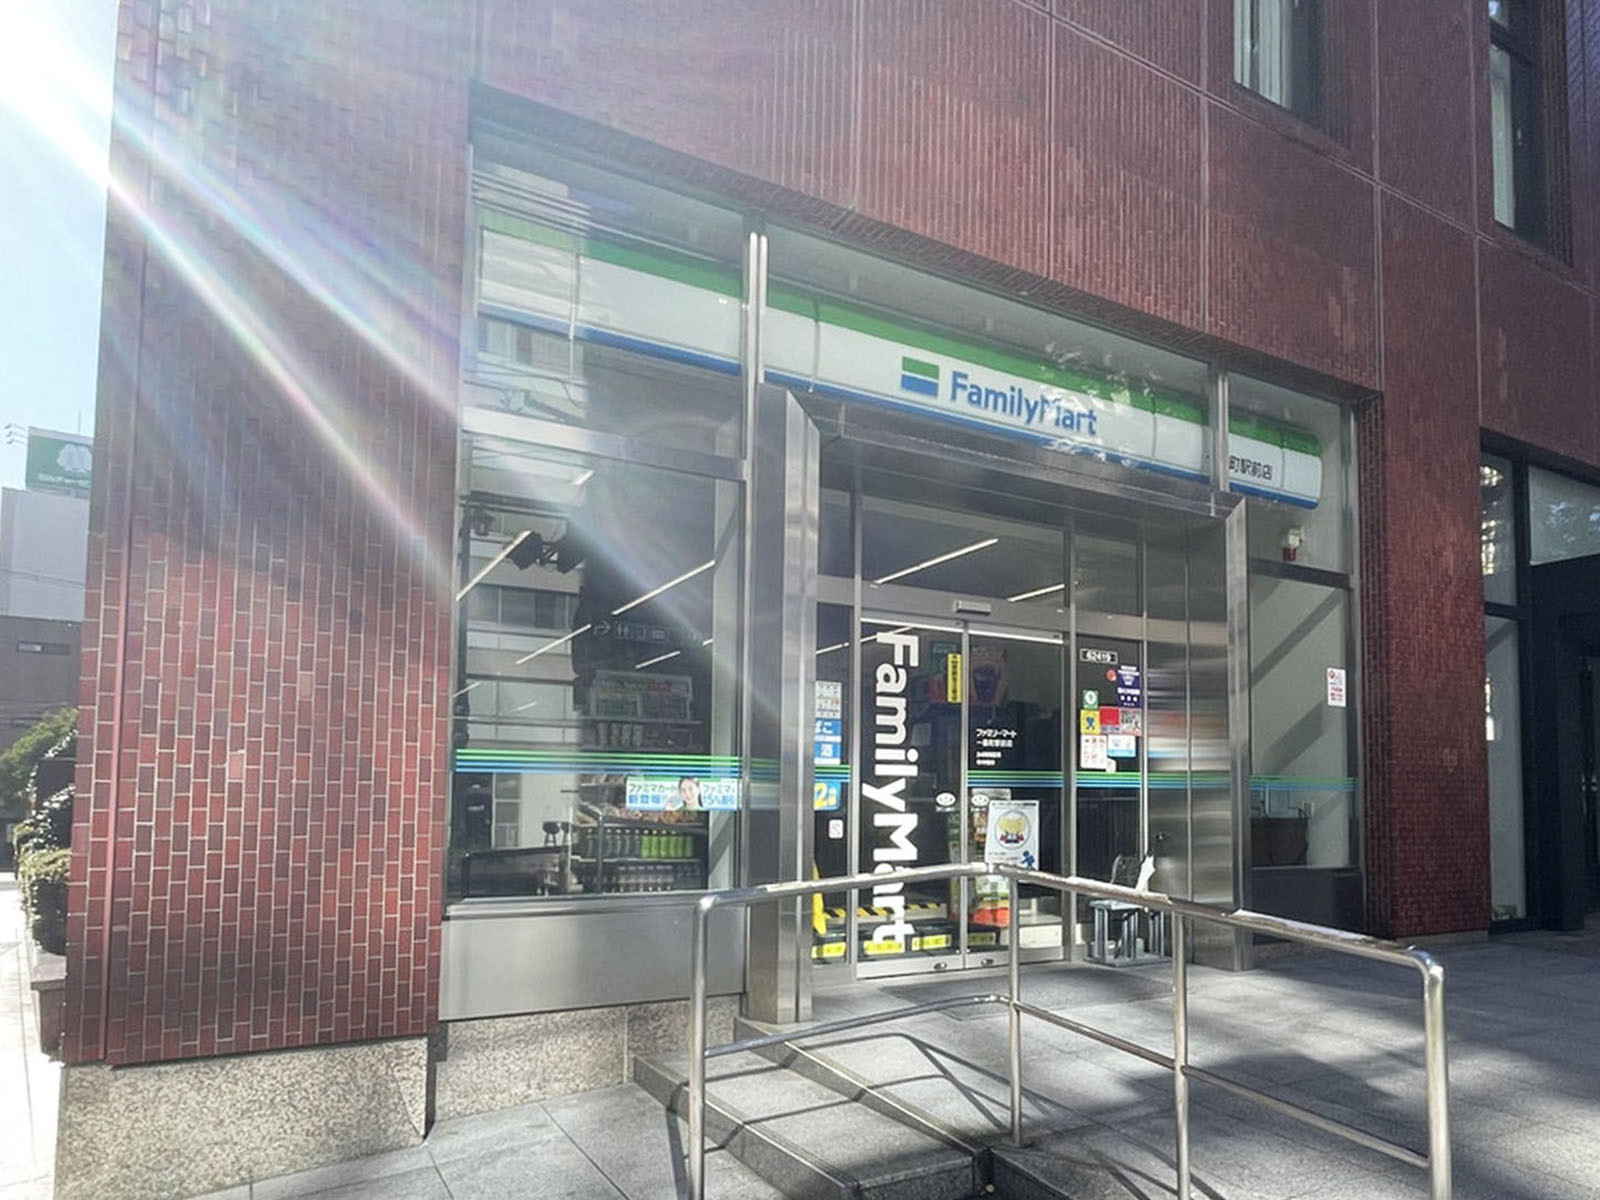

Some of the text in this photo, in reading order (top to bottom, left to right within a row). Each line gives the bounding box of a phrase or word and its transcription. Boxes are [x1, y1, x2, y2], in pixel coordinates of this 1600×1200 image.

[951, 370, 1098, 436] FamilyMart
[1229, 455, 1273, 480] 町駅前店
[862, 632, 919, 947] FamilyMart
